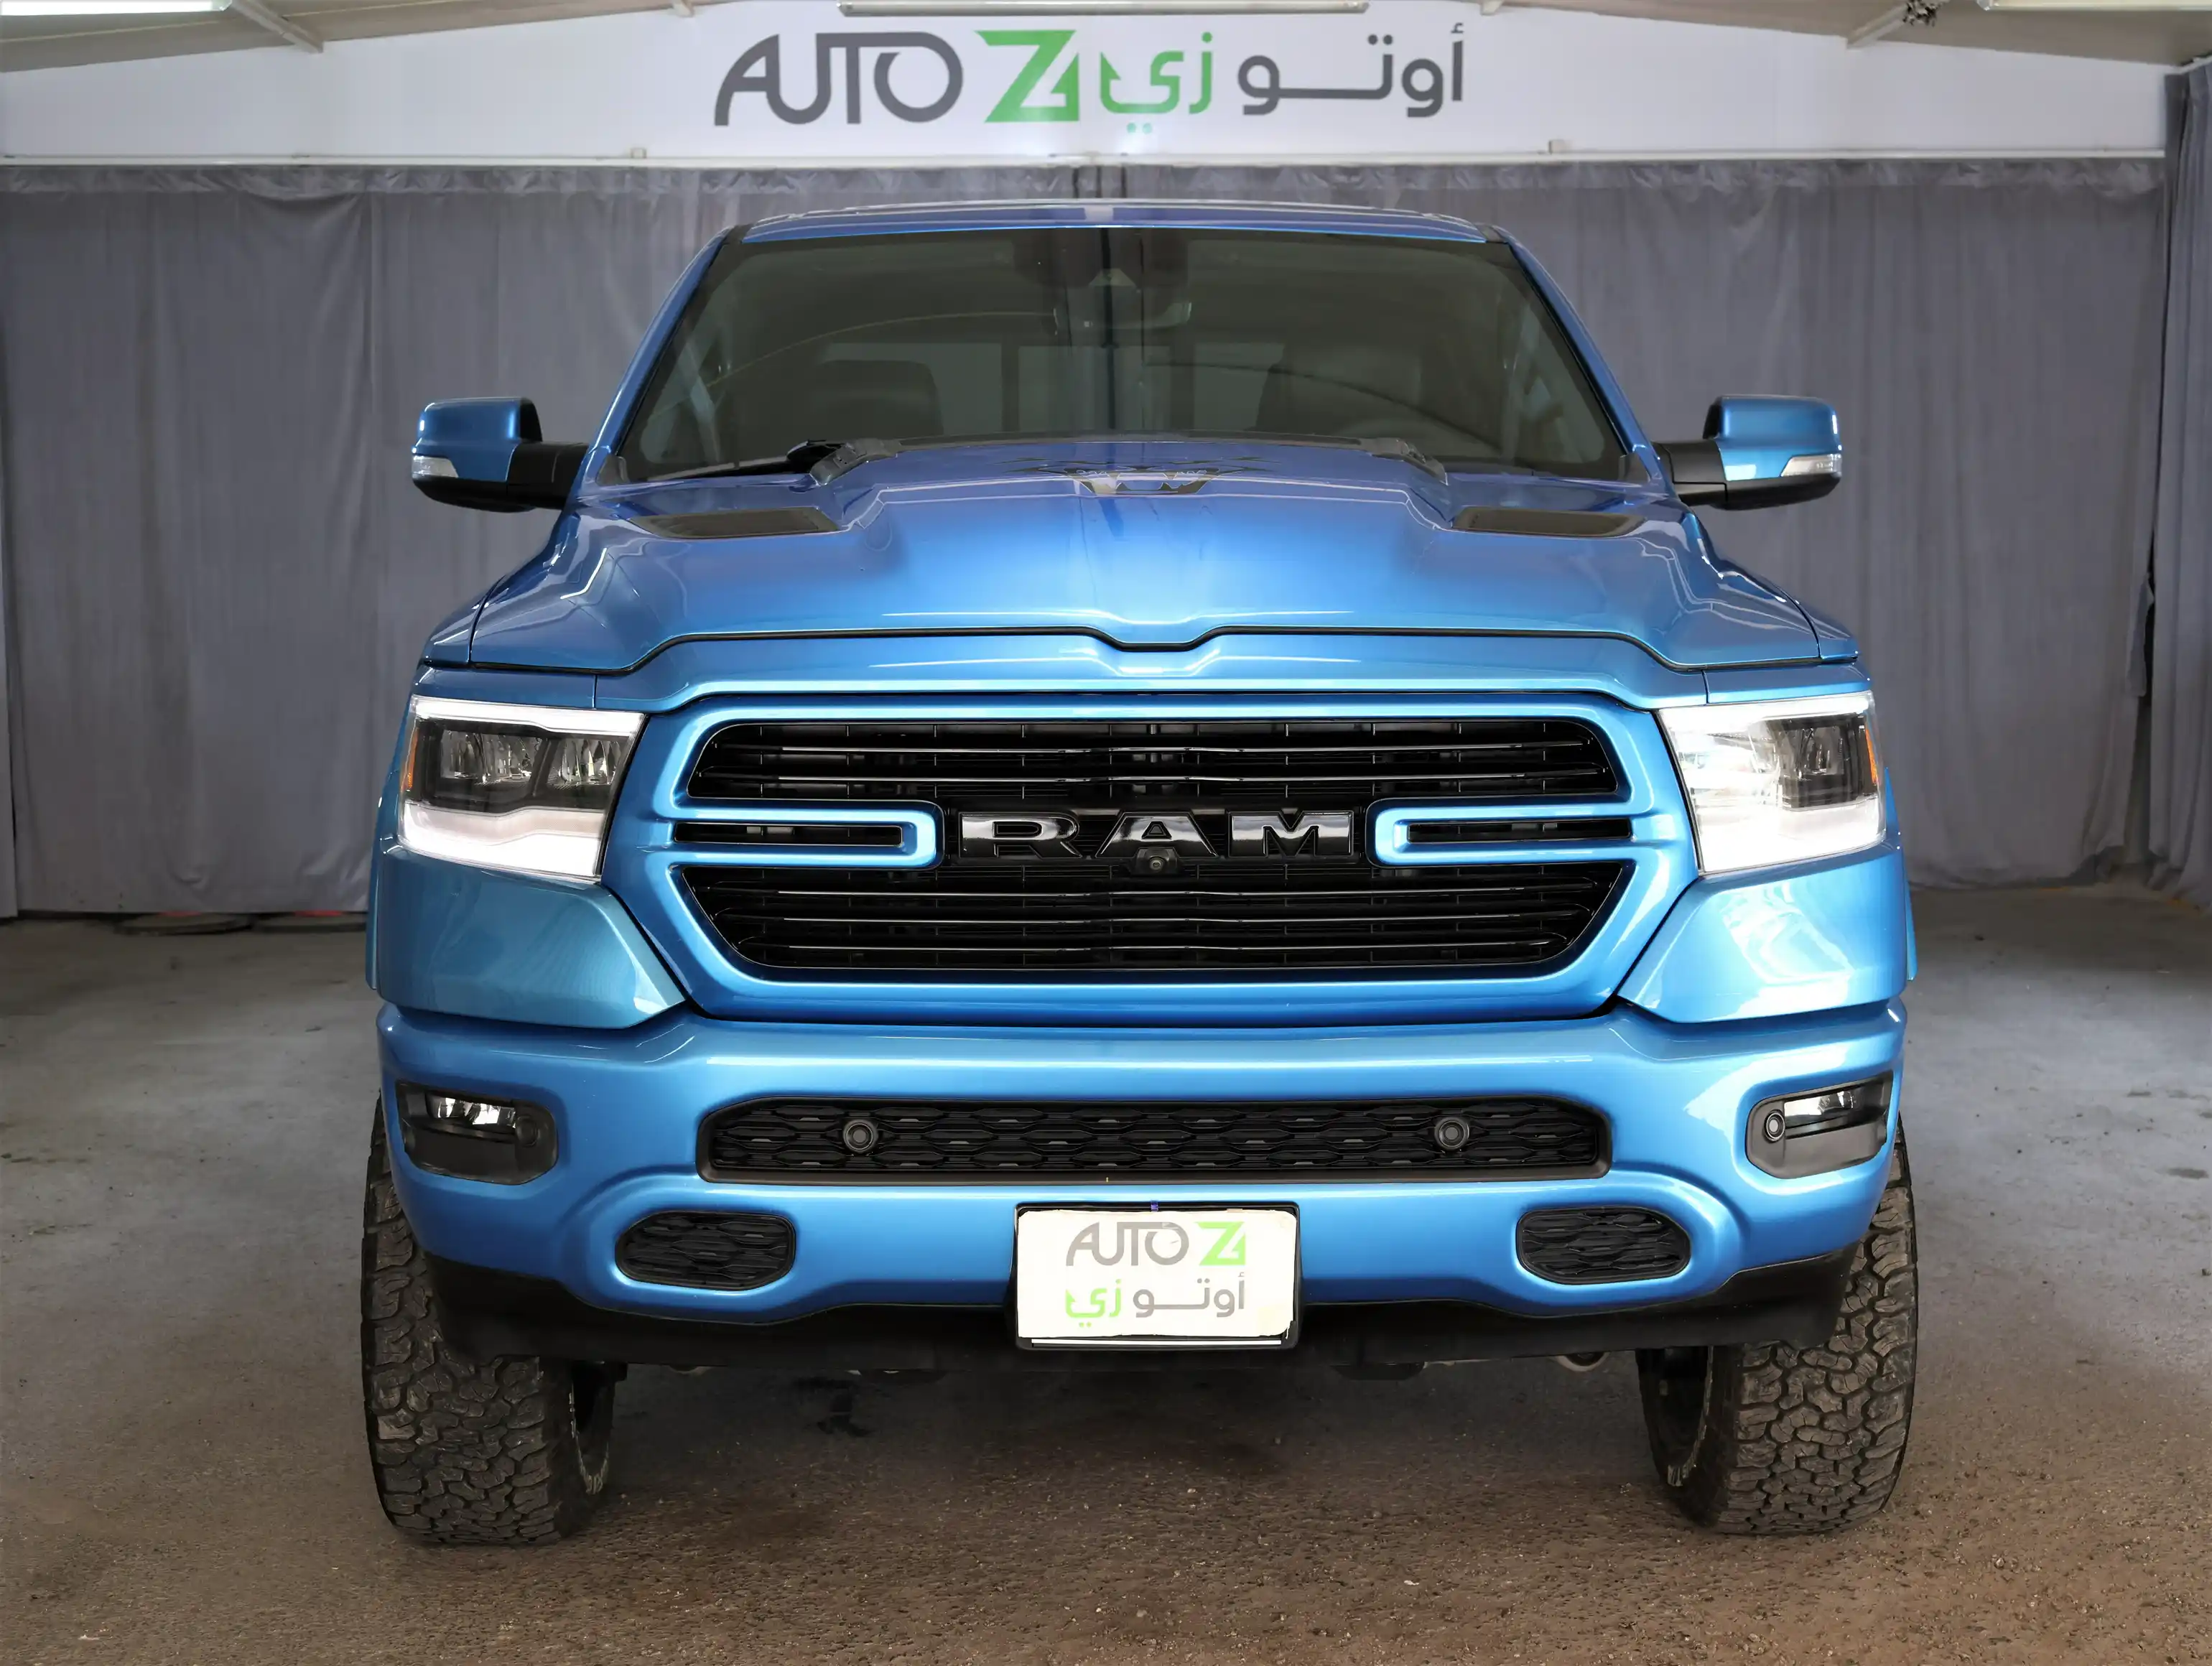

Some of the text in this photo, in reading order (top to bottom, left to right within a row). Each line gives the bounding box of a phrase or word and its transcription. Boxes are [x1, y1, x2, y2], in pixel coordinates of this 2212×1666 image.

[714, 32, 964, 126] AUTO
[1100, 32, 1213, 134] زي
[958, 810, 1354, 859] RAM
[1066, 1221, 1189, 1266] AUTO
[1065, 1278, 1122, 1328] زي
